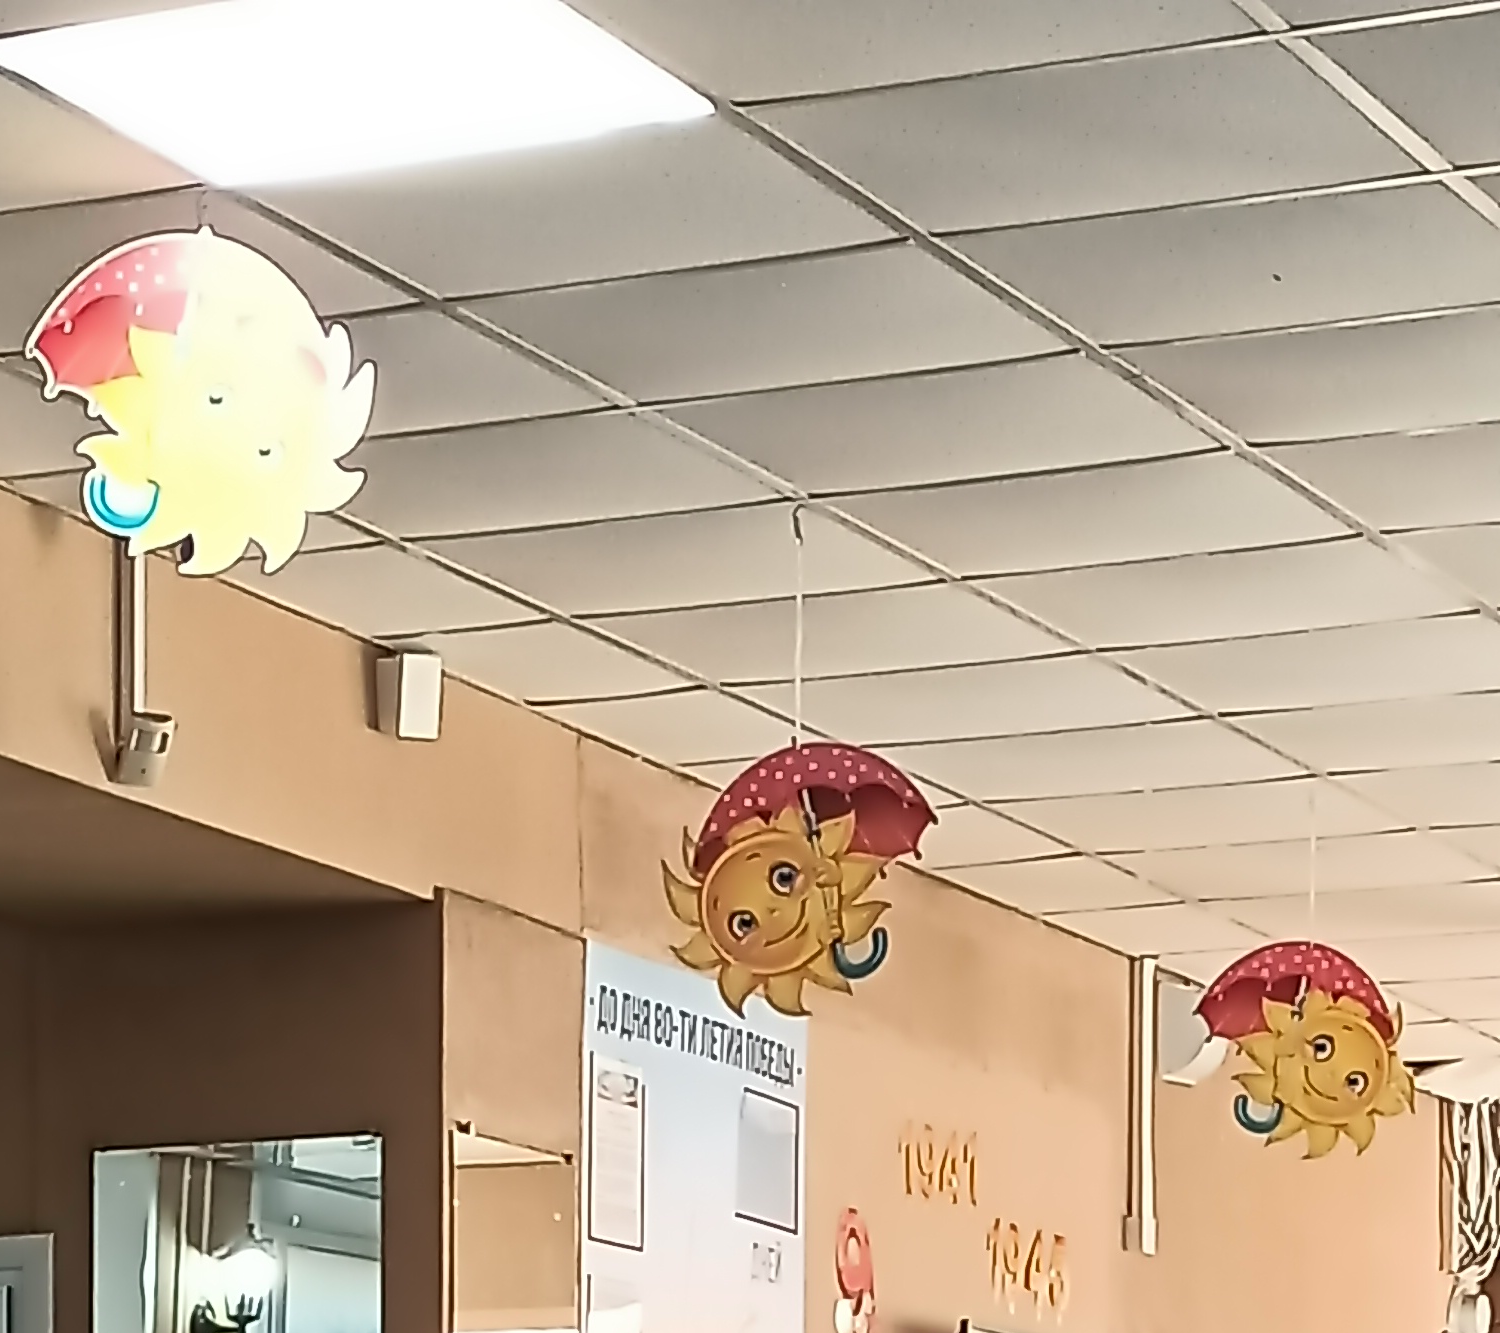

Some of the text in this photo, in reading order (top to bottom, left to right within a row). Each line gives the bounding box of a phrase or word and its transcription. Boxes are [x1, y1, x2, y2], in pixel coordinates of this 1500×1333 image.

[596, 984, 618, 1035] ДО
[619, 992, 651, 1042] ДНЯ
[699, 1016, 743, 1070] ЛЕТИЯ
[745, 1031, 795, 1088] ПОБЕДЫ
[897, 1121, 977, 1207] 1941
[985, 1217, 1066, 1310] 1945
